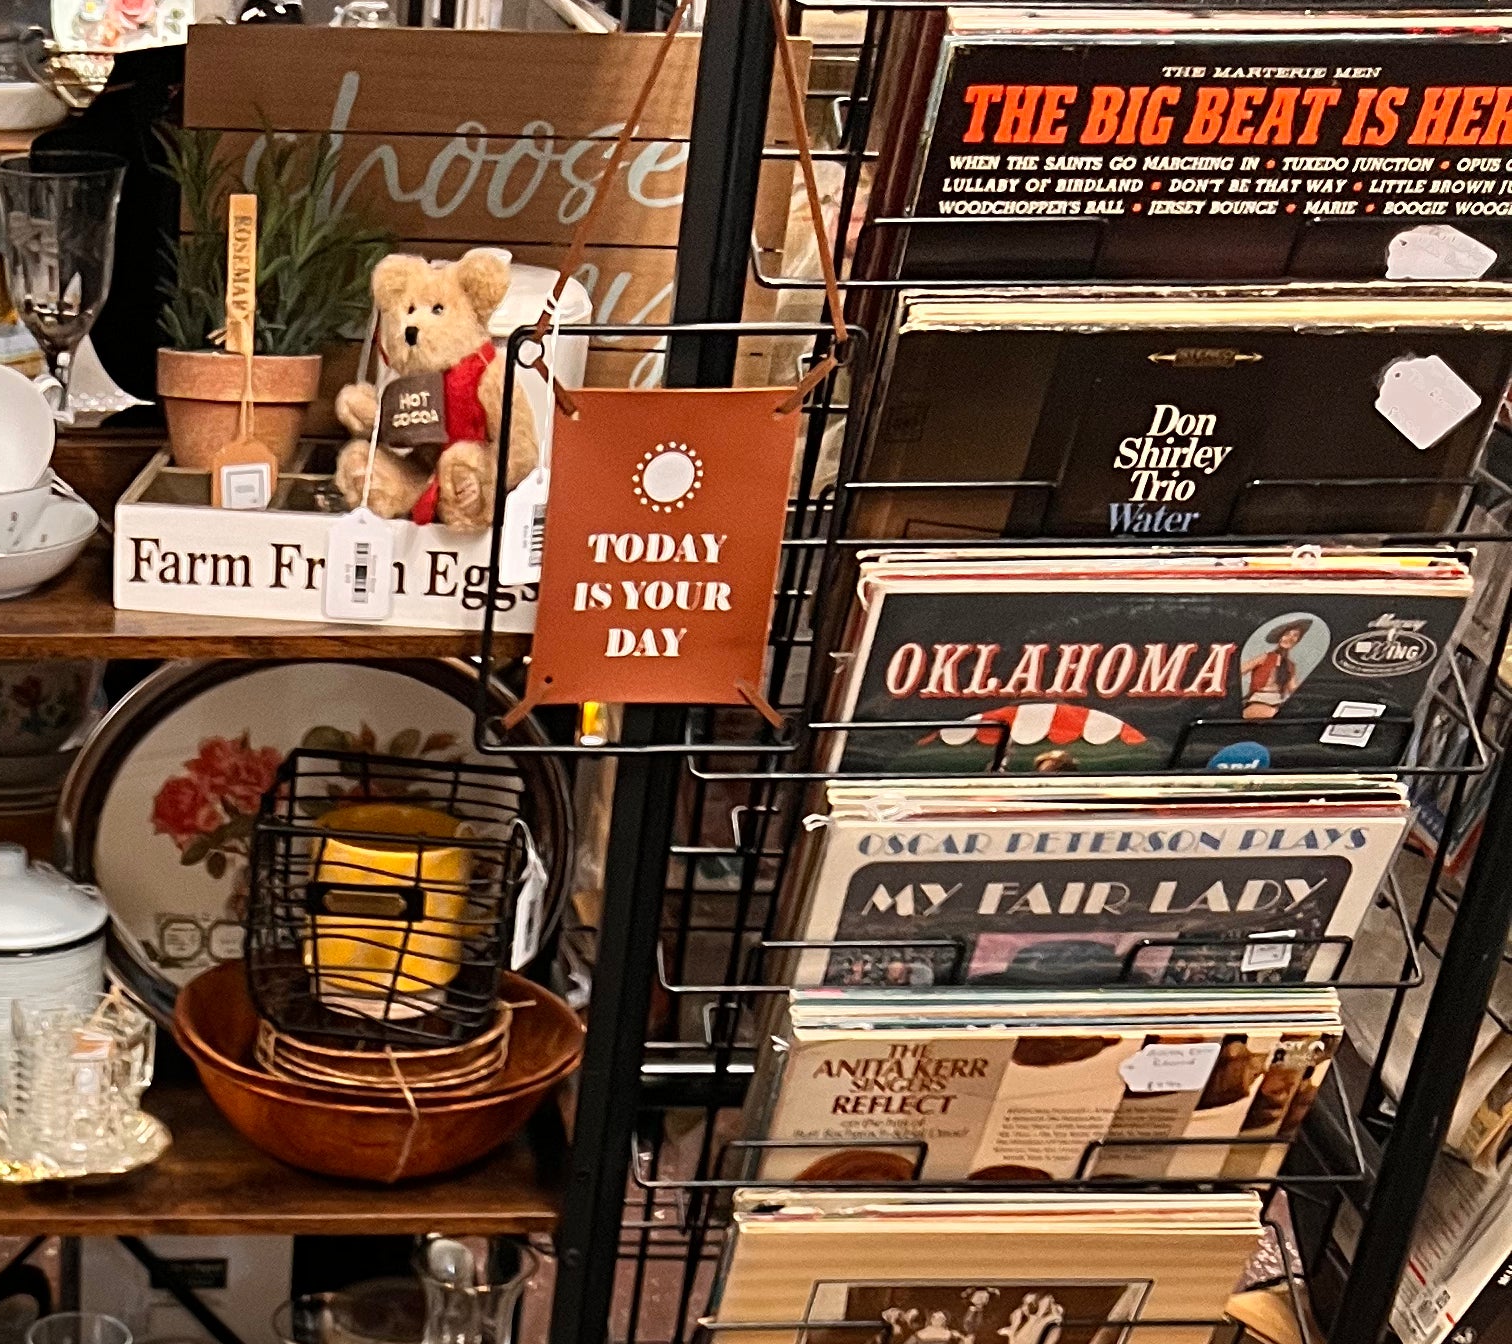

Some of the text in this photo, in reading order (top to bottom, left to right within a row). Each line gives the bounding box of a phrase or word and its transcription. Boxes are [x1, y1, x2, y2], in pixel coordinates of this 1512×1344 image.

[1162, 67, 1207, 78] THE
[1333, 67, 1382, 78] MEN
[962, 84, 1078, 144] THE
[1079, 86, 1182, 146] BIG
[1183, 86, 1342, 146] BEAT
[1342, 87, 1410, 146] IS
[949, 155, 1000, 170] WHEN
[1006, 155, 1039, 170] THE
[1044, 156, 1103, 171] SAINTS
[1109, 156, 1137, 170] GO
[1143, 156, 1234, 171] MARCHING
[1240, 157, 1260, 171] IN
[1282, 157, 1349, 172] TUXEDO
[1352, 157, 1434, 173] JUNCTION
[1456, 158, 1503, 172] OPUS
[942, 178, 1020, 192] LULLABY
[1025, 178, 1051, 193] OF
[1055, 178, 1144, 193] BIRDLAND
[1168, 178, 1224, 193] DON'T
[1228, 179, 1251, 193] BE
[1255, 179, 1301, 193] THAT
[1306, 179, 1348, 193] WAY
[1369, 179, 1428, 194] LITTLE
[1429, 180, 1497, 194] BROWN
[938, 200, 1080, 215] WOODCHOPPER'S
[1084, 201, 1125, 214] BALL
[1148, 201, 1207, 215] JERSEY
[1209, 201, 1280, 215] BOUNCE
[1303, 201, 1359, 215] MARIE
[1383, 201, 1449, 215] BOOGIE
[232, 215, 253, 324] ROSEMAR
[399, 391, 431, 410] HOT
[392, 411, 439, 428] COCOA
[1146, 404, 1217, 437] Don
[1113, 437, 1234, 475] Shirley
[1128, 470, 1196, 502] Trio
[1108, 502, 1202, 534] Water
[128, 537, 252, 588] Farm
[588, 533, 728, 563] TODAY
[573, 580, 733, 612] IS YOUR
[604, 627, 688, 658] DAY
[886, 642, 1238, 698] OKLAHOMA
[858, 826, 1369, 855] OSCAR PETERSON PLAYS
[861, 877, 1328, 917] MY FAIR LADY
[888, 1043, 928, 1058] THE
[813, 1058, 988, 1078] ANITA KERR
[832, 1095, 958, 1115] REFLECT
